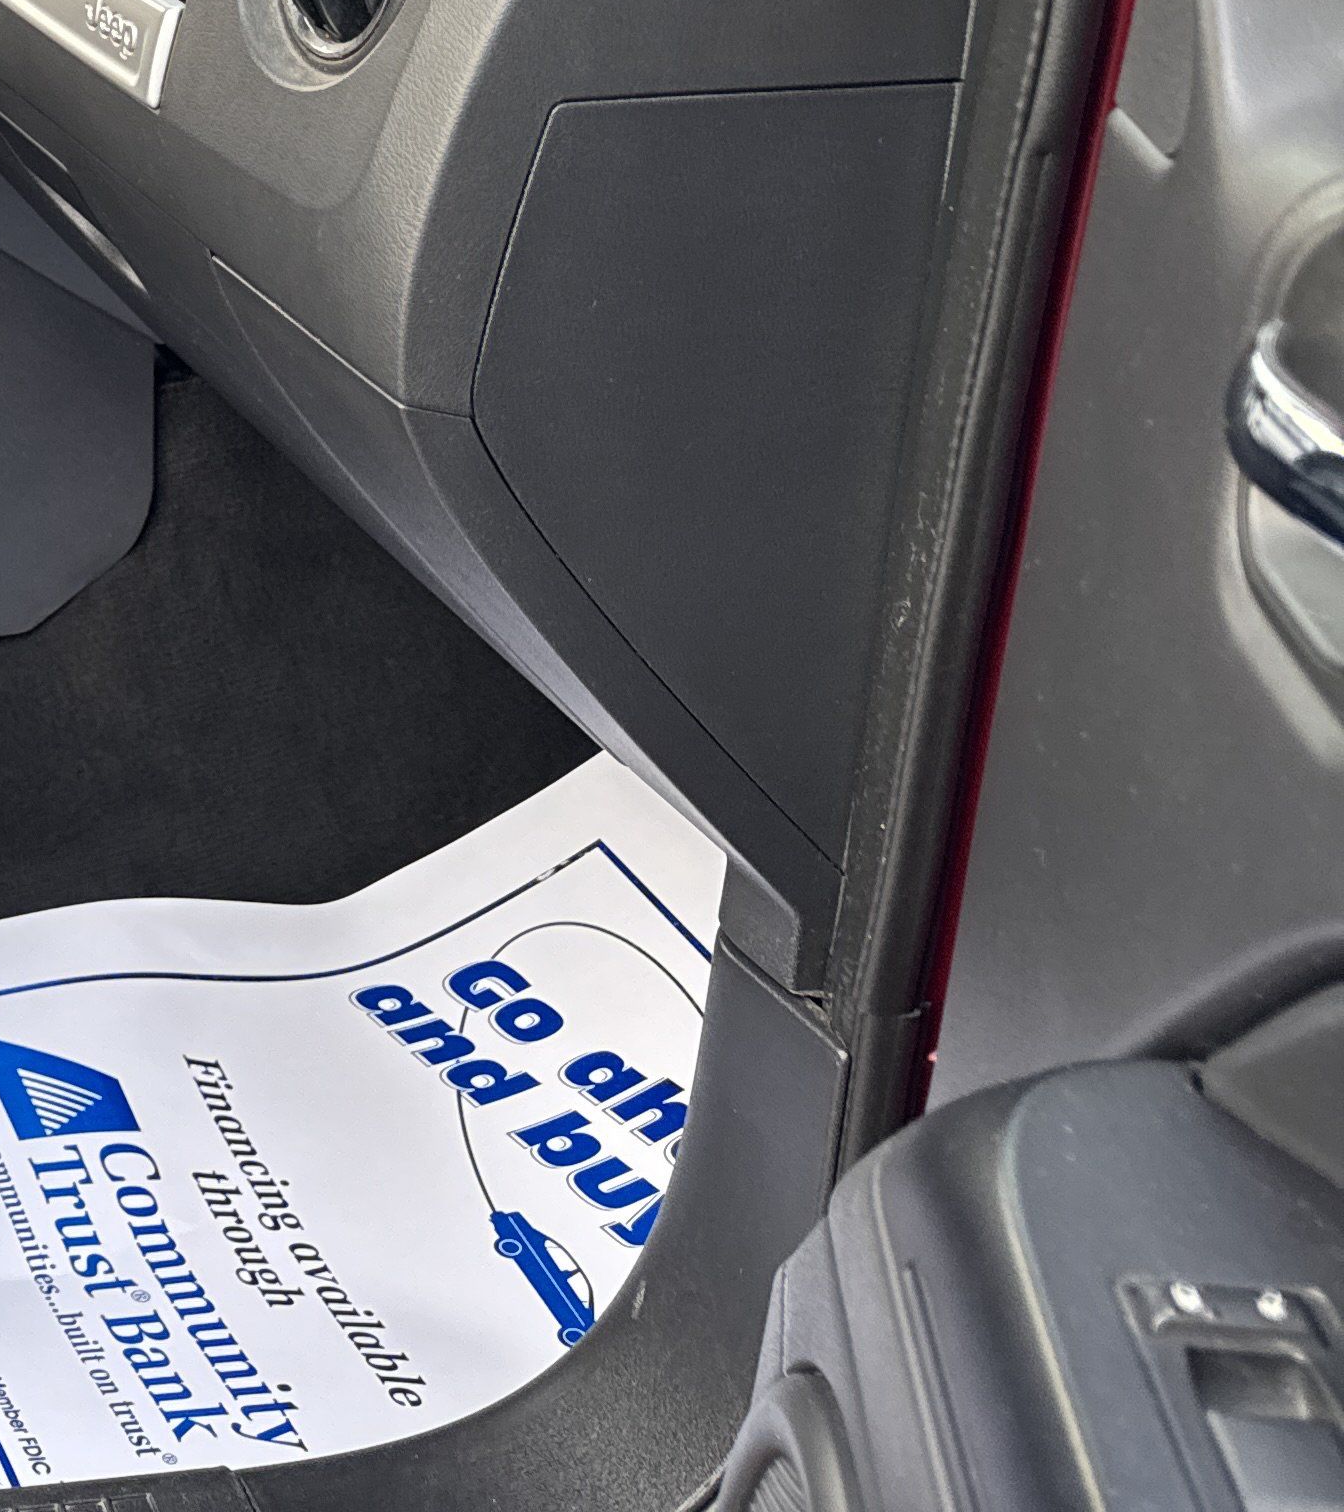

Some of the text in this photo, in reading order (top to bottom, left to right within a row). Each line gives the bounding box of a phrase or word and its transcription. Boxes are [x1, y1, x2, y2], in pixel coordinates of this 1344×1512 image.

[349, 984, 542, 1109] and
[443, 959, 690, 1167] Go ah
[99, 1142, 309, 1453] Community
[183, 1054, 428, 1408] Financing available
[192, 1169, 306, 1308] through
[89, 1366, 121, 1397] on
[100, 1309, 230, 1443] Bank
[18, 1437, 51, 1476] FDIC
